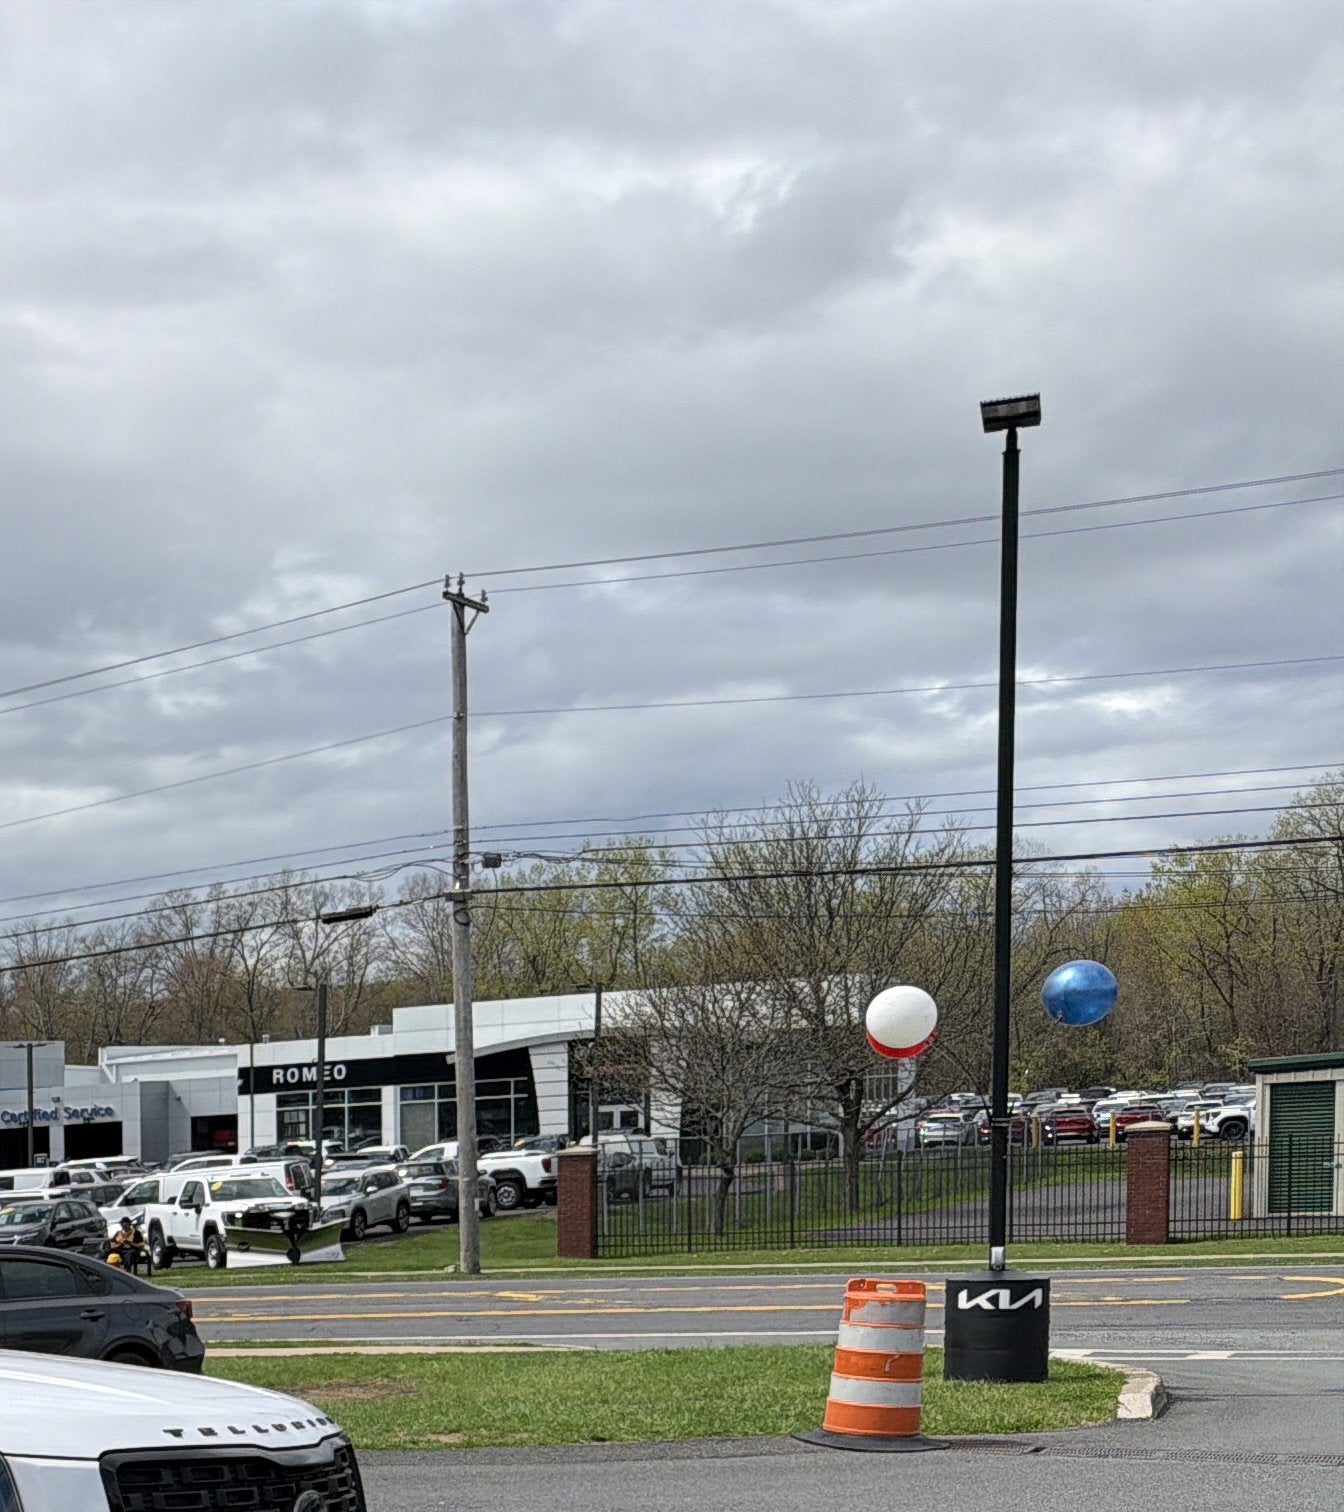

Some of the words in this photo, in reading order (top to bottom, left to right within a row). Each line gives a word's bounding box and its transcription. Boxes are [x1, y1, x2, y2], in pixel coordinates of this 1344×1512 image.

[272, 1064, 347, 1085] ROMEO
[0, 1107, 59, 1124] Certfied
[63, 1104, 115, 1120] Service
[957, 1287, 1044, 1310] KIA
[162, 1416, 336, 1439] TELLURIDE
